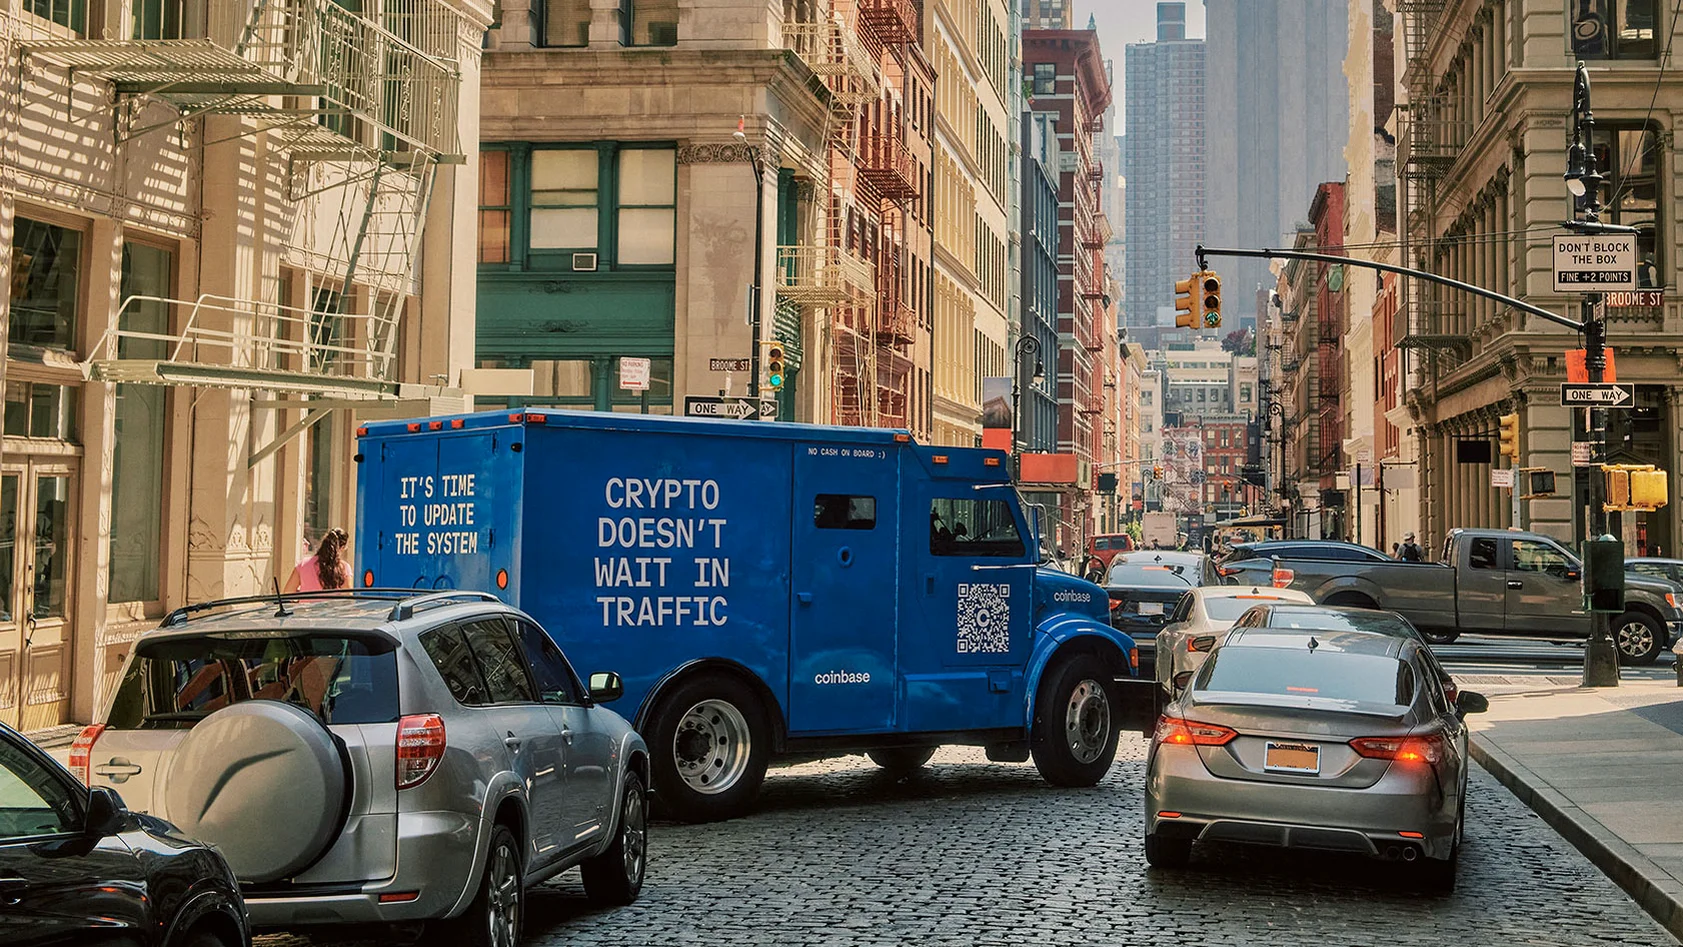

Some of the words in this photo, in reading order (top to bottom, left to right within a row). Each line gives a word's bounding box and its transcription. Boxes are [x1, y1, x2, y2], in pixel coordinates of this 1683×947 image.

[1559, 243, 1589, 252] DON'T
[1594, 243, 1630, 252] BLOCK
[1572, 255, 1592, 264] THE
[1596, 255, 1617, 264] BOX
[1561, 272, 1580, 282] FINE
[1582, 272, 1597, 281] +2
[1599, 272, 1629, 281] POINTS
[1650, 292, 1662, 305] ST
[711, 361, 737, 371] BROOME
[740, 361, 749, 371] ST
[1571, 391, 1592, 400] ONE
[1601, 391, 1622, 400] WAY
[695, 403, 717, 414] ONE
[726, 405, 749, 415] WAY
[808, 447, 818, 456] NO
[820, 448, 838, 456] CASH
[841, 448, 850, 457] ON
[853, 449, 875, 458] BOARD
[400, 475, 434, 499] IT'S
[442, 474, 475, 497] TIME
[605, 477, 720, 510] CRYPTO
[400, 504, 416, 527] TO
[424, 503, 474, 526] UPDATE
[598, 517, 727, 548] DOESN'T
[395, 533, 419, 554] THE
[427, 532, 478, 554] SYSTEM
[594, 557, 672, 587] WAIT
[694, 558, 729, 587] IN
[1053, 589, 1091, 602] coinbase
[596, 596, 728, 626] TRAFFIC
[814, 669, 871, 684] coinbase
